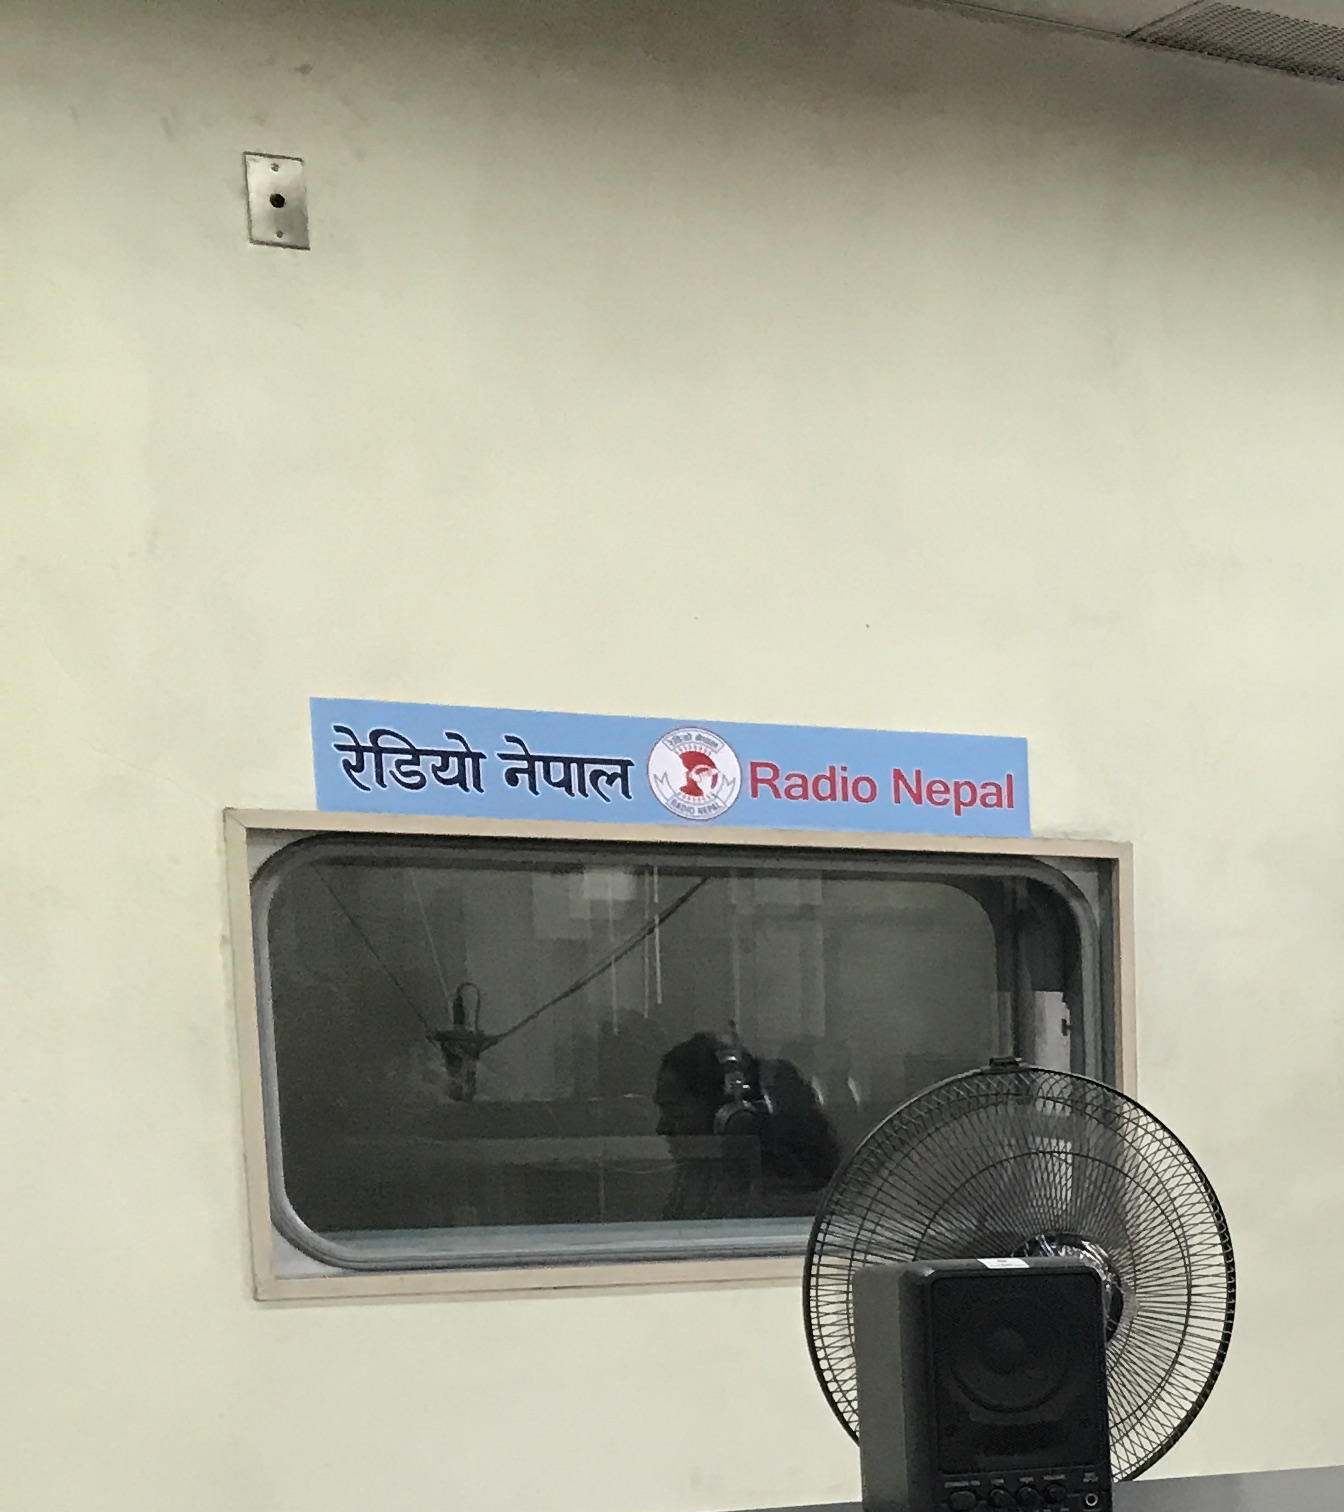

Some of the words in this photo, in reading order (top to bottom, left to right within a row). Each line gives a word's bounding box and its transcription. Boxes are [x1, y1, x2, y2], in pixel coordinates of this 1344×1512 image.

[332, 724, 485, 795] रेडियो
[497, 735, 635, 801] नेपाल
[749, 762, 879, 804] Radio
[892, 767, 1016, 816] Nepal
